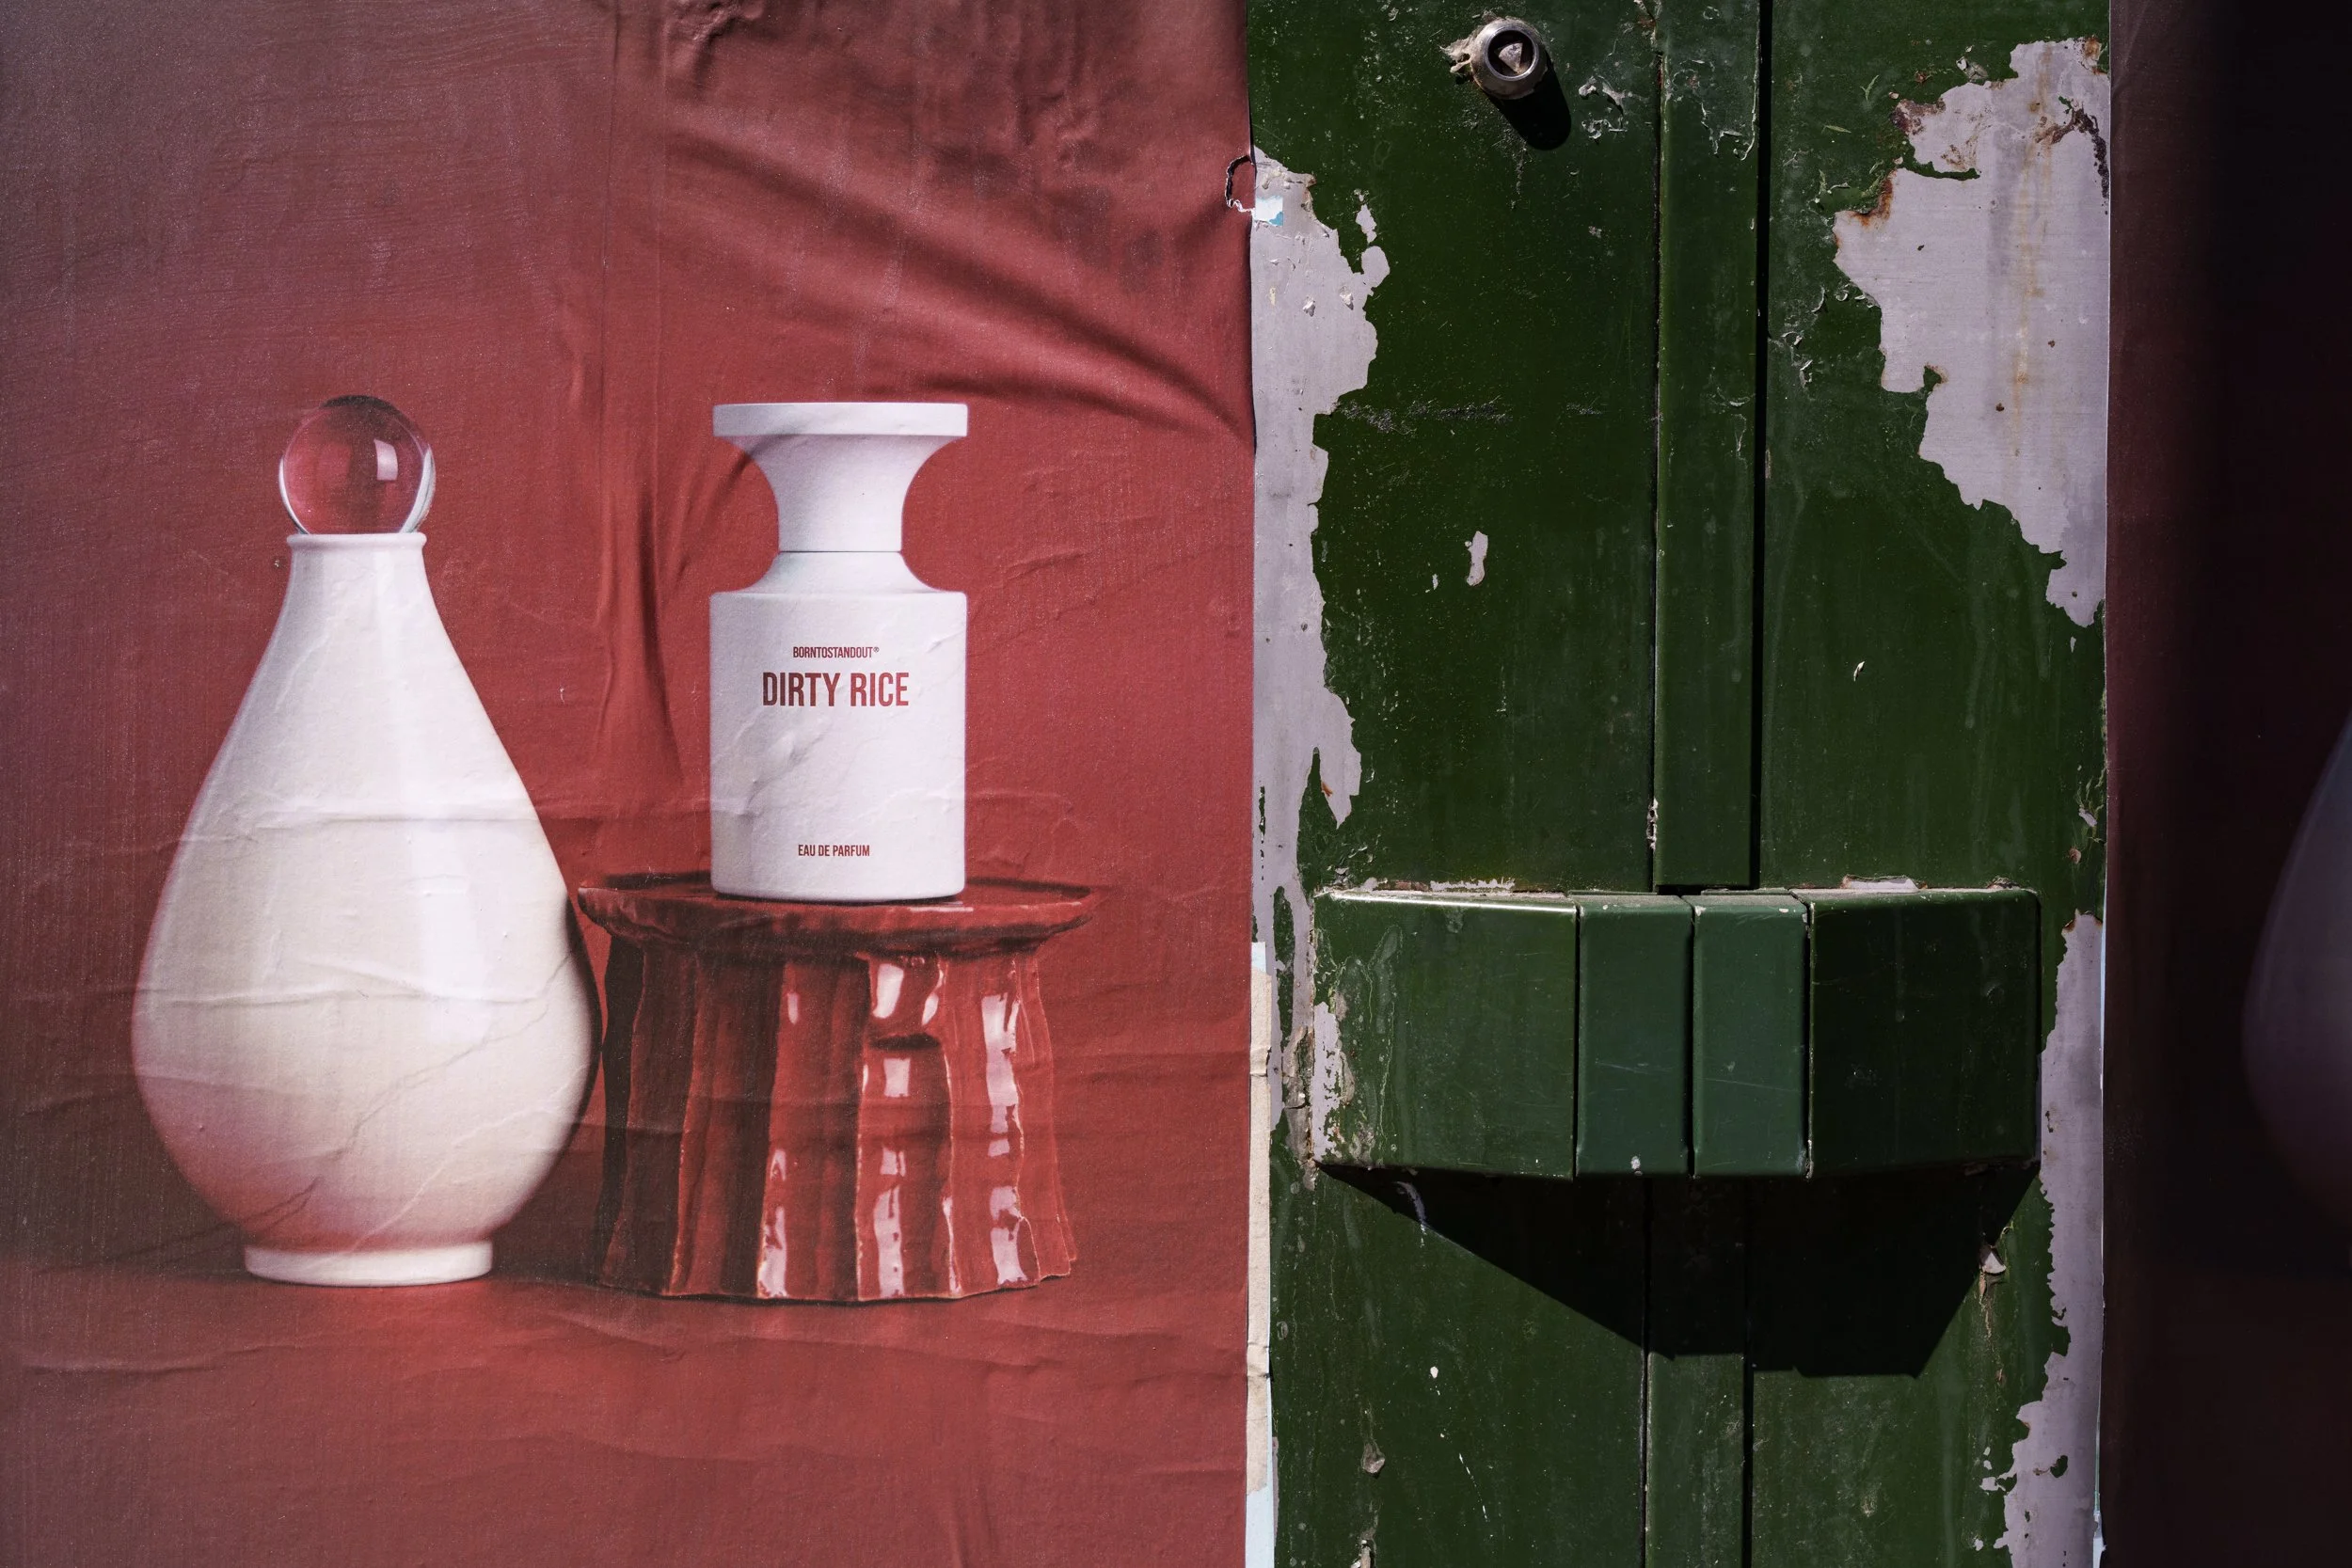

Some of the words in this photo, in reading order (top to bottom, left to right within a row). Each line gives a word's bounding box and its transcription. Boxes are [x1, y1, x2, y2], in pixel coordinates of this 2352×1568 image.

[762, 672, 840, 706] DIRTY
[850, 672, 909, 706] RICE
[798, 844, 816, 857] EAU
[818, 844, 831, 857] DE
[833, 844, 870, 857] PARFUM
